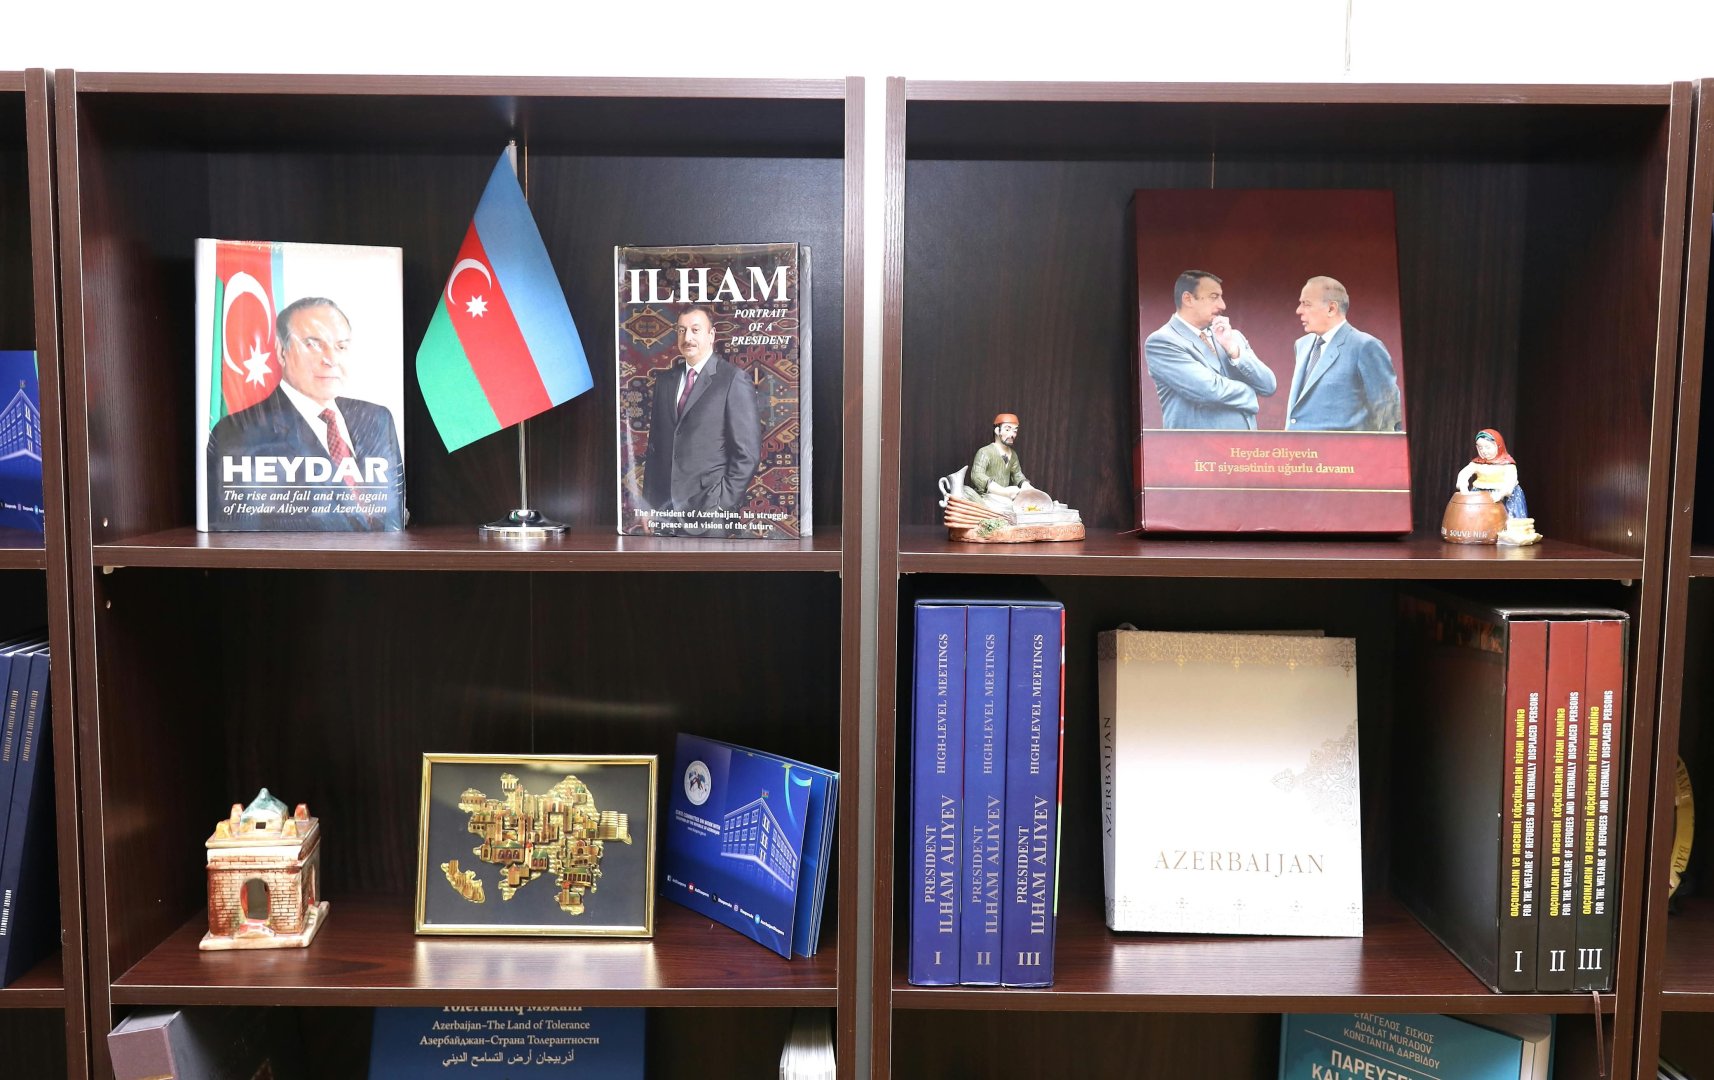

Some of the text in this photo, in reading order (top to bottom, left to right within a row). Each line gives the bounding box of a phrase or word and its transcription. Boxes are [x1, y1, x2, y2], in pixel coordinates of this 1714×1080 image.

[627, 266, 791, 303] ILHAM
[734, 309, 788, 318] PORTRAIT
[749, 323, 772, 332] OF A
[731, 336, 791, 345] PRESIDENT
[1230, 448, 1318, 460] Heydər Əliyevin
[223, 456, 388, 483] HEYDAR
[1194, 460, 1354, 476] İKT siyasətinin uğurlu davamı
[224, 491, 388, 503] The rise and fall and rise again
[223, 504, 387, 515] of Heydar Aliyev and Azerbaijan
[634, 509, 648, 517] The
[651, 509, 685, 517] President
[687, 509, 696, 517] of
[744, 511, 755, 519] his
[756, 511, 788, 521] struggle
[660, 522, 682, 530] peace
[684, 521, 698, 529] and
[725, 522, 733, 530] of
[734, 522, 747, 530] the
[750, 522, 773, 530] future
[937, 634, 948, 774] HIGH-LEVEL MEETINGS
[984, 634, 995, 774] HIGH-LEVEL MEETINGS
[1030, 634, 1043, 774] HIGH-LEVEL MEETINGS
[1514, 740, 1524, 764] RİFAHI
[1554, 740, 1564, 763] RİFAHI
[1587, 738, 1598, 761] RİFAHI
[1104, 717, 1112, 838] AZERBAIJAN
[1523, 692, 1538, 916] FOR THE WELFARE OF REFUGEES AND INTERNALLY DISPLACED PERSONS
[1562, 692, 1578, 916] FOR THE WELFARE OF REFUGEES AND INTERNALLY DISPLACED PERSONS
[1595, 690, 1613, 914] FOR THE WELFARE OF REFUGEES AND INTERNALLY DISPLACED PERSONS
[924, 825, 936, 903] PRESIDENT
[940, 795, 955, 933] ILHAM ALIYEV
[972, 826, 983, 903] PRESIDENT
[986, 795, 1000, 933] ILHAM ALIYEV
[1017, 826, 1030, 904] PRESIDENT
[1031, 795, 1048, 935] ILHAM ALIYEV
[1154, 851, 1324, 878] AZERBAIJAN
[934, 952, 942, 965] I
[977, 952, 991, 965] II
[1018, 952, 1041, 966] III
[1514, 951, 1523, 972] I
[1550, 950, 1566, 971] II
[1578, 948, 1603, 970] III
[508, 1021, 531, 1030] Land
[533, 1020, 543, 1029] of
[545, 1020, 590, 1029] Tolerance
[1405, 1026, 1434, 1043] ΣΙΣΚΟΣ
[527, 1035, 599, 1046] Толерантности
[1355, 1021, 1431, 1054] ADALAT MURADOV
[1396, 1048, 1440, 1070] ΔΑΡΒΙΔΟΥ
